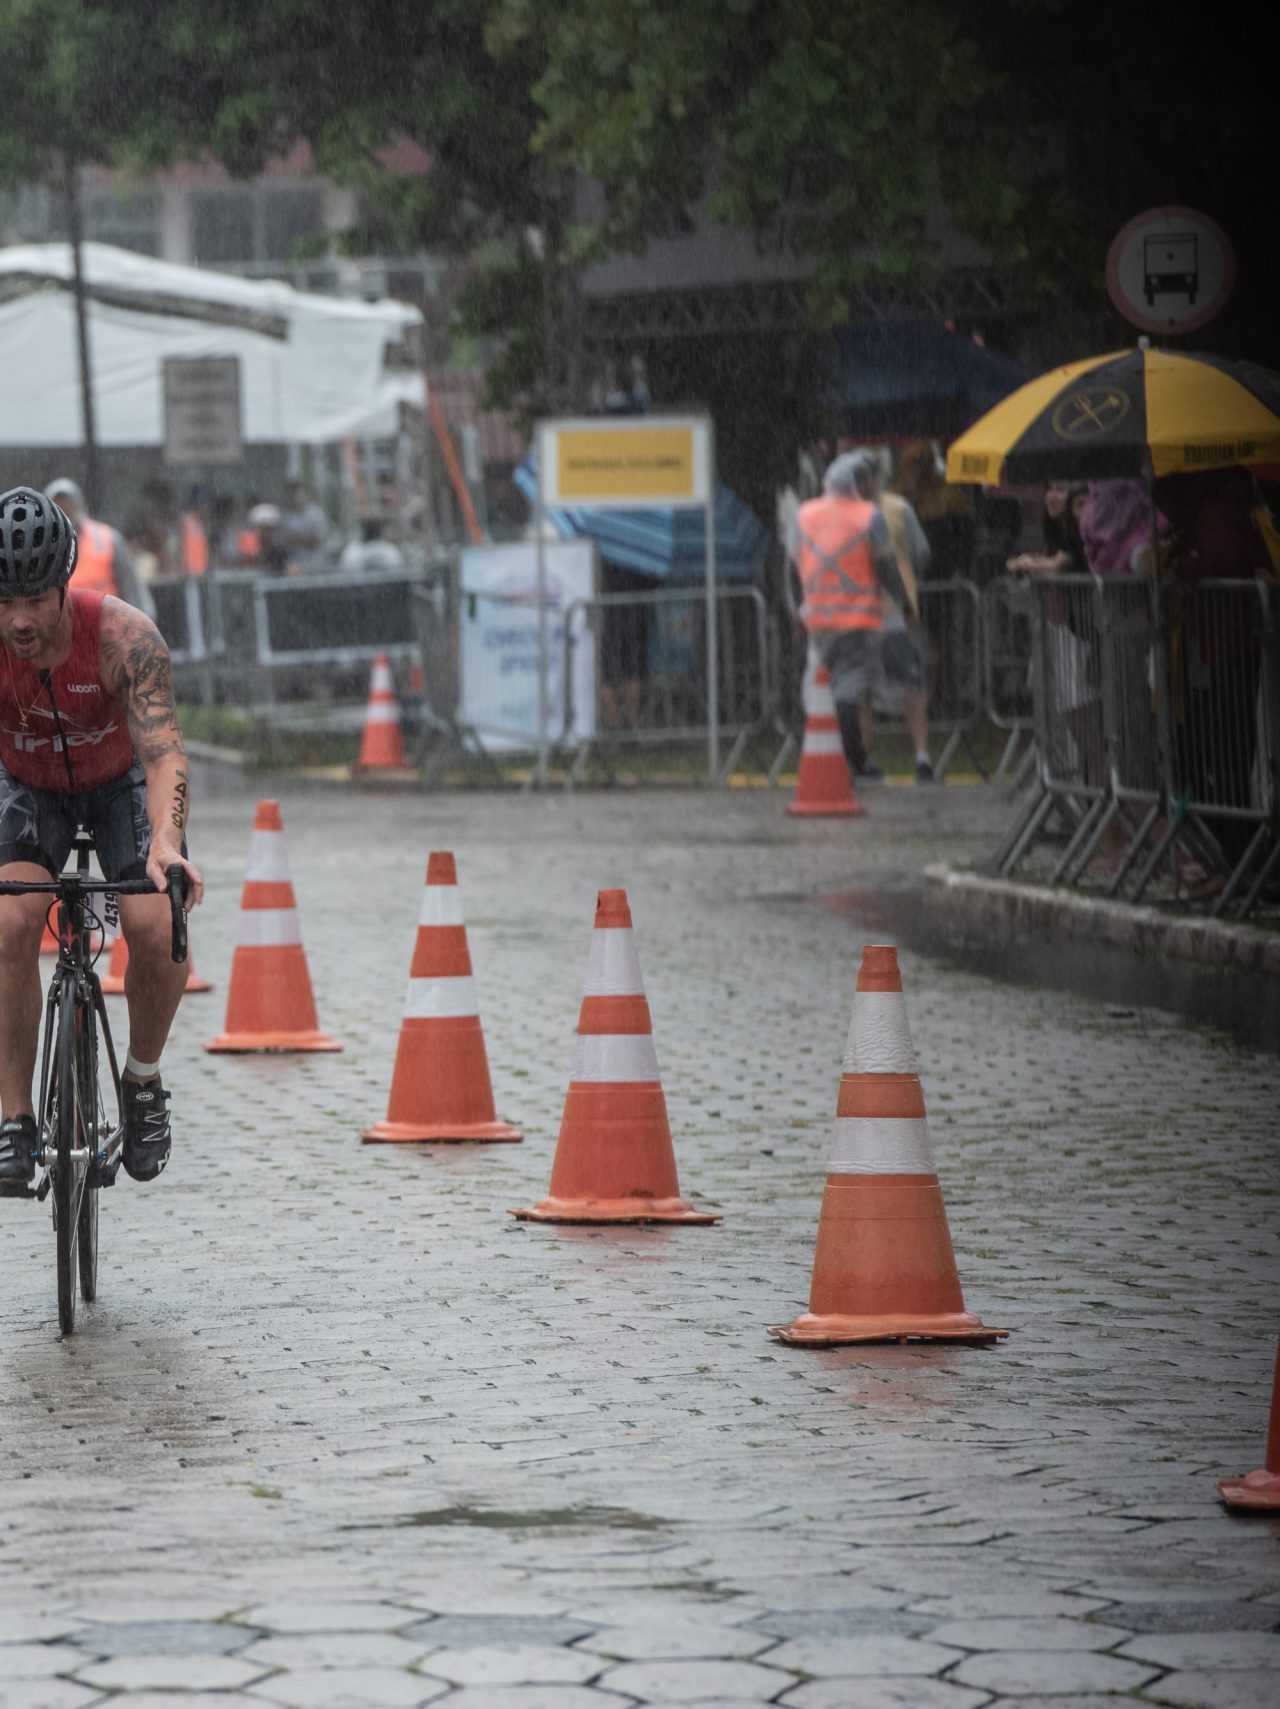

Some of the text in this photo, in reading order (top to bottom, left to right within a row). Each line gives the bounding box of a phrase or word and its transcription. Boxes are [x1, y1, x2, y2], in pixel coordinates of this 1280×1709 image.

[67, 683, 100, 694] woom
[172, 782, 187, 829] 439
[104, 891, 119, 928] 439
